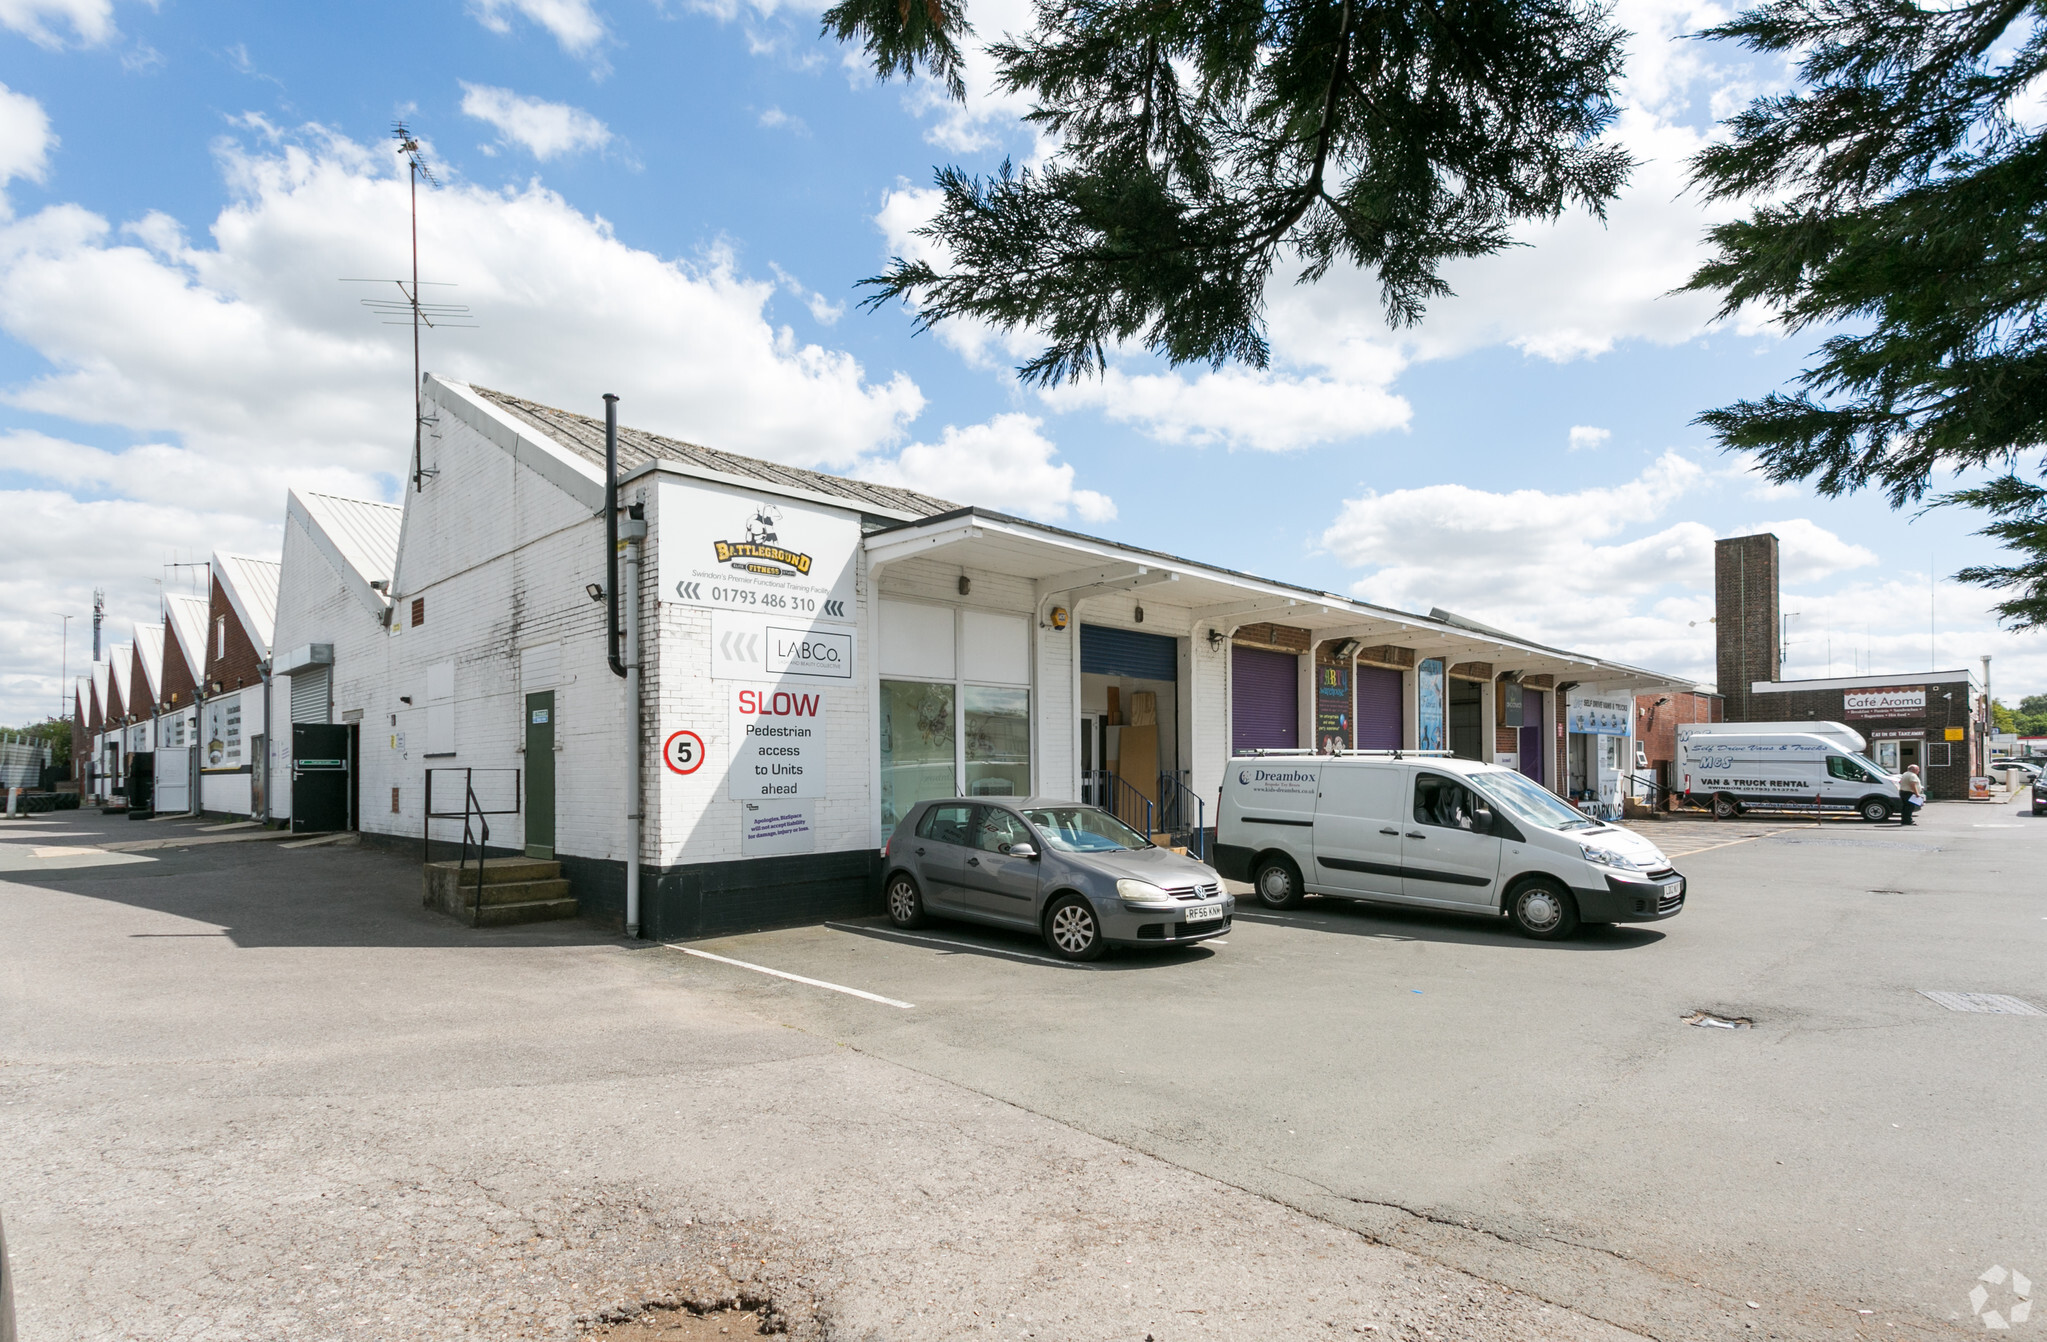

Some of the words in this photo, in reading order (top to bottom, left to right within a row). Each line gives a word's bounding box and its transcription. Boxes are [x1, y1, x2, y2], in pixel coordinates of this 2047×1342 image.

[716, 542, 811, 573] BATTLEGROUND
[748, 564, 780, 575] FITNESS
[692, 569, 727, 581] Swindon's
[727, 574, 753, 584] Premier
[753, 577, 786, 589] Functional
[786, 582, 810, 594] Training
[810, 585, 832, 596] Facility
[712, 586, 757, 605] 01793
[761, 593, 786, 608] 486
[791, 596, 815, 612] 310
[778, 639, 841, 662] LABCo.
[738, 690, 821, 717] SLOW
[1847, 697, 1877, 707] Café
[1880, 697, 1922, 706] Aroma
[746, 724, 812, 738] Pedestrian
[677, 742, 692, 763] 5
[758, 745, 800, 756] access
[755, 765, 768, 775] to
[772, 763, 803, 775] Units
[1700, 756, 1734, 769] M&S
[1255, 770, 1316, 782] Dreambox
[761, 783, 798, 795] ahead
[1701, 778, 1720, 786] VAN
[1733, 779, 1767, 787] TRUCK
[1770, 780, 1809, 788] RENTAL
[1592, 803, 1622, 819] PARKING
[1189, 907, 1208, 919] RF56
